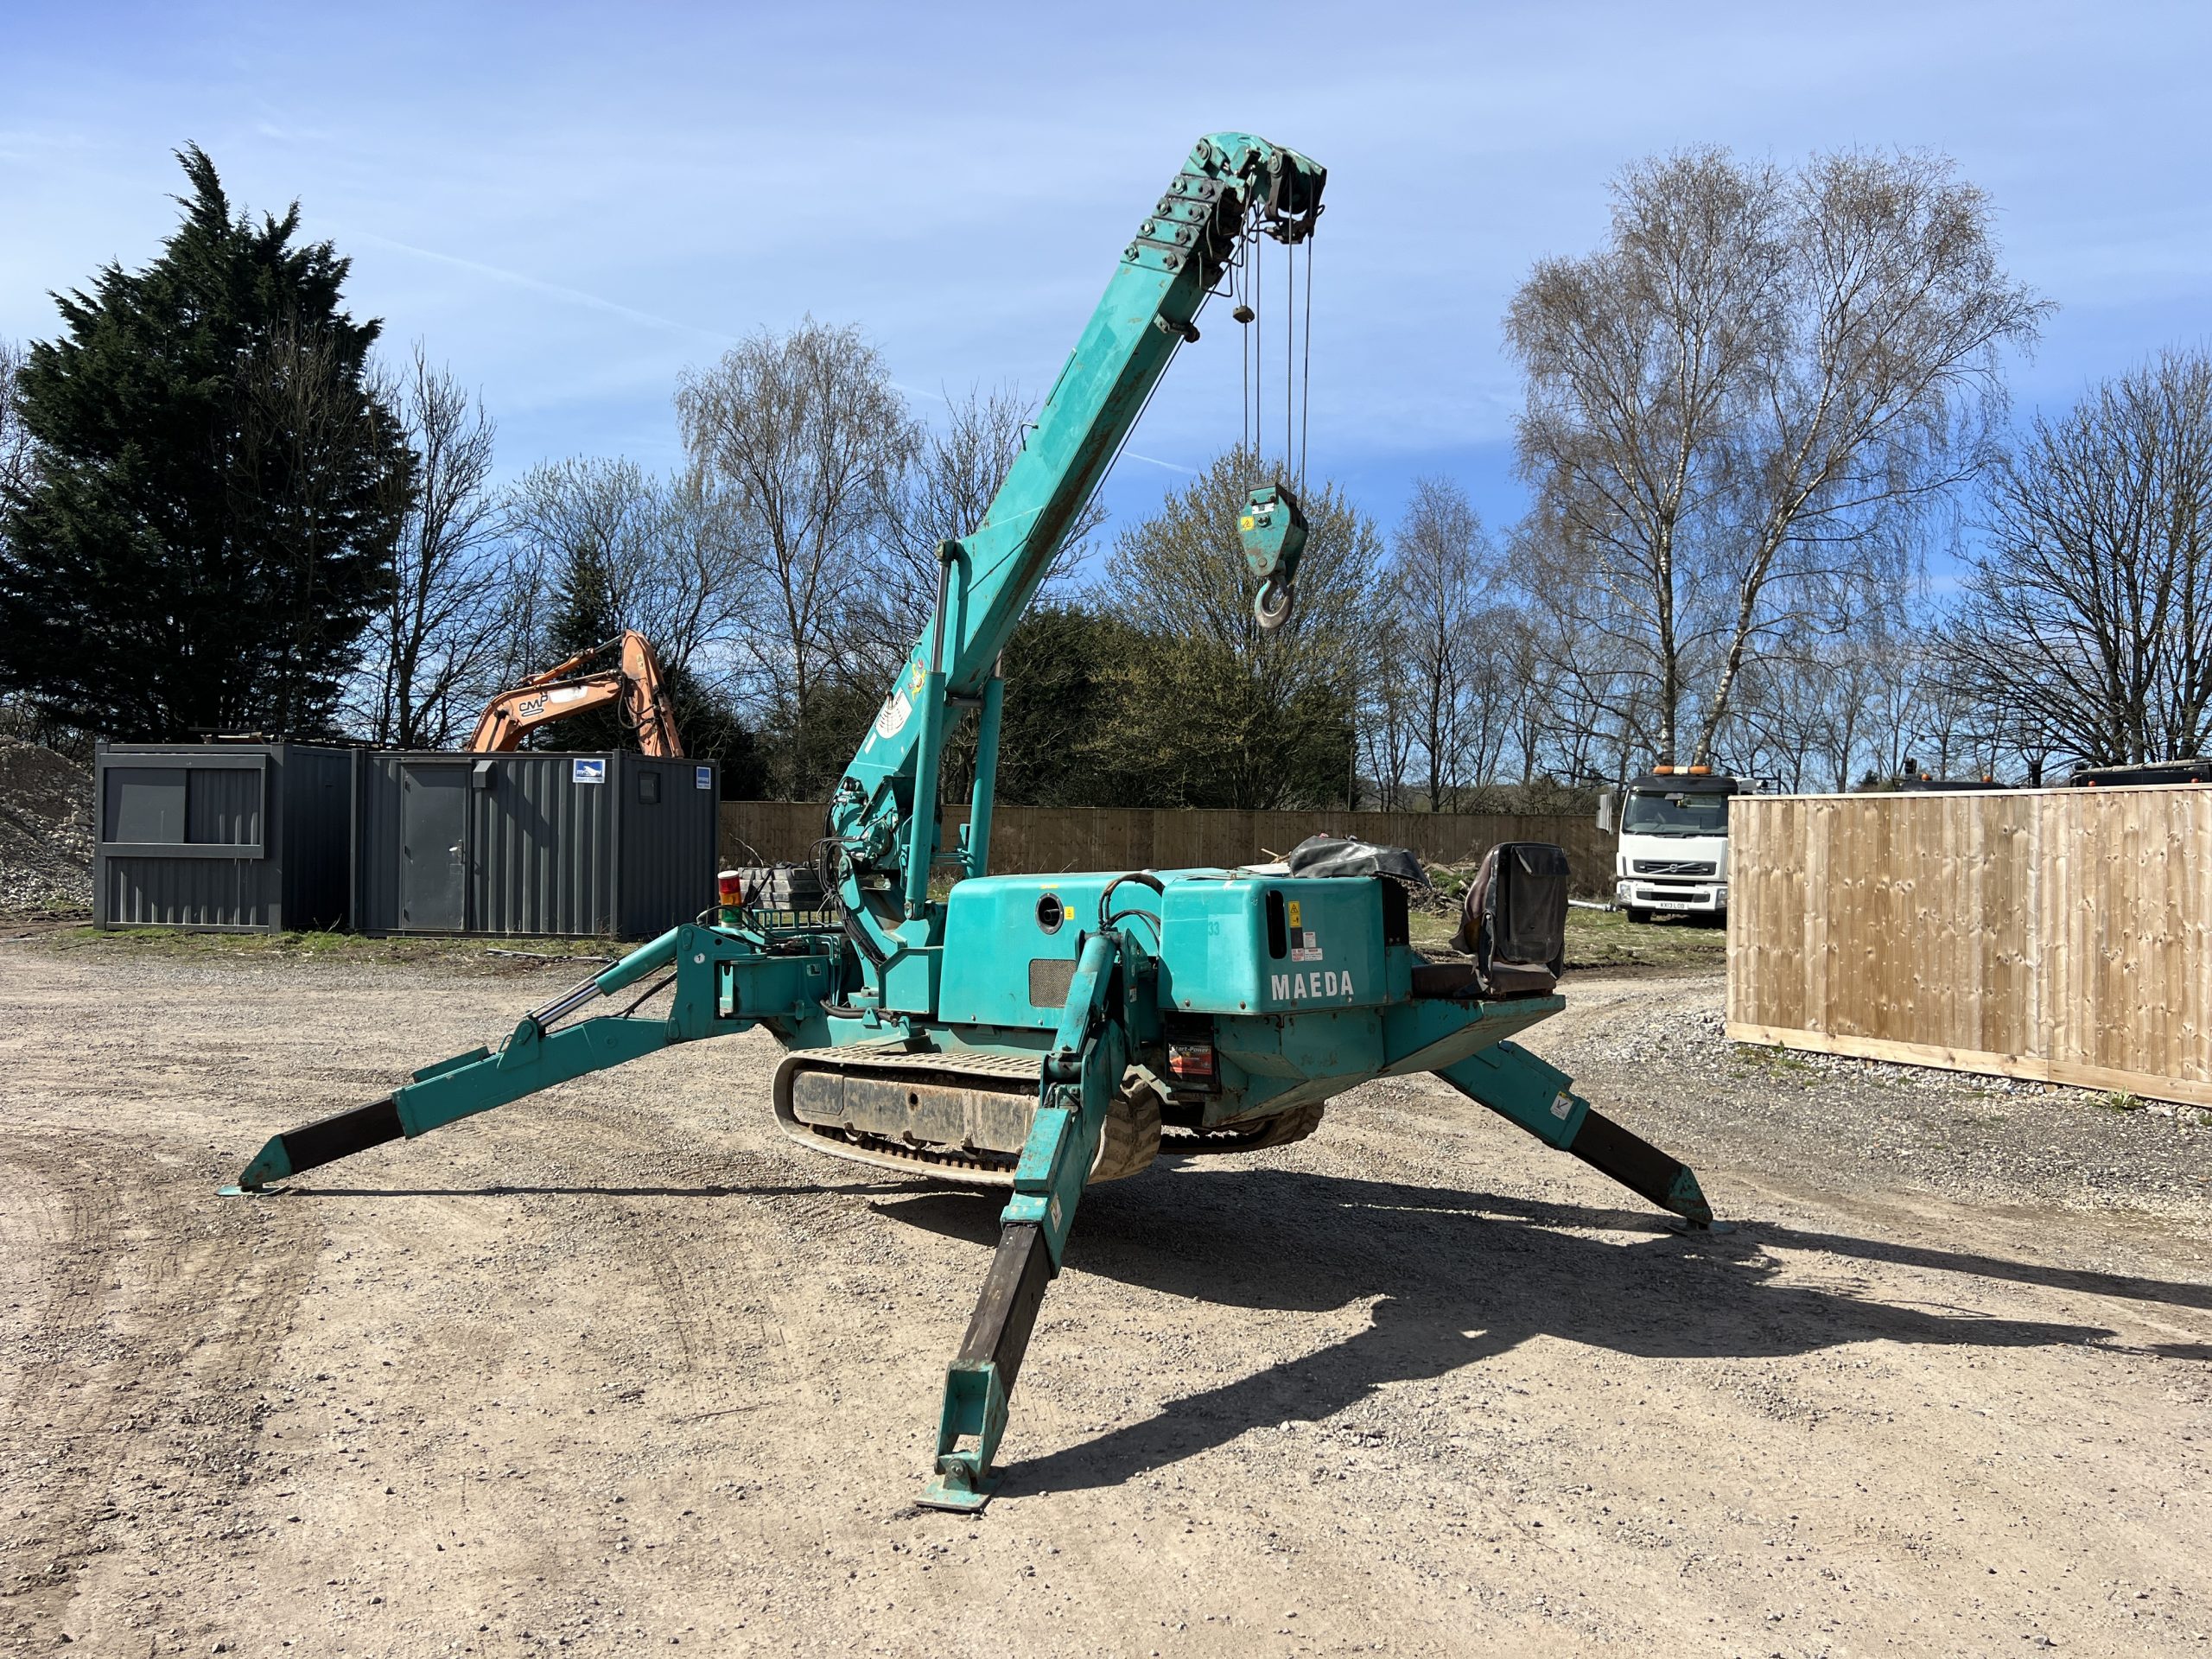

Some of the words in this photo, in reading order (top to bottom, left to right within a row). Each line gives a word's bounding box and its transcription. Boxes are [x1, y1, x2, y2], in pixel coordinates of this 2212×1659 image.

[519, 694, 548, 711] CMP
[1208, 921, 1219, 936] 33
[1271, 970, 1354, 1001] MAEDA
